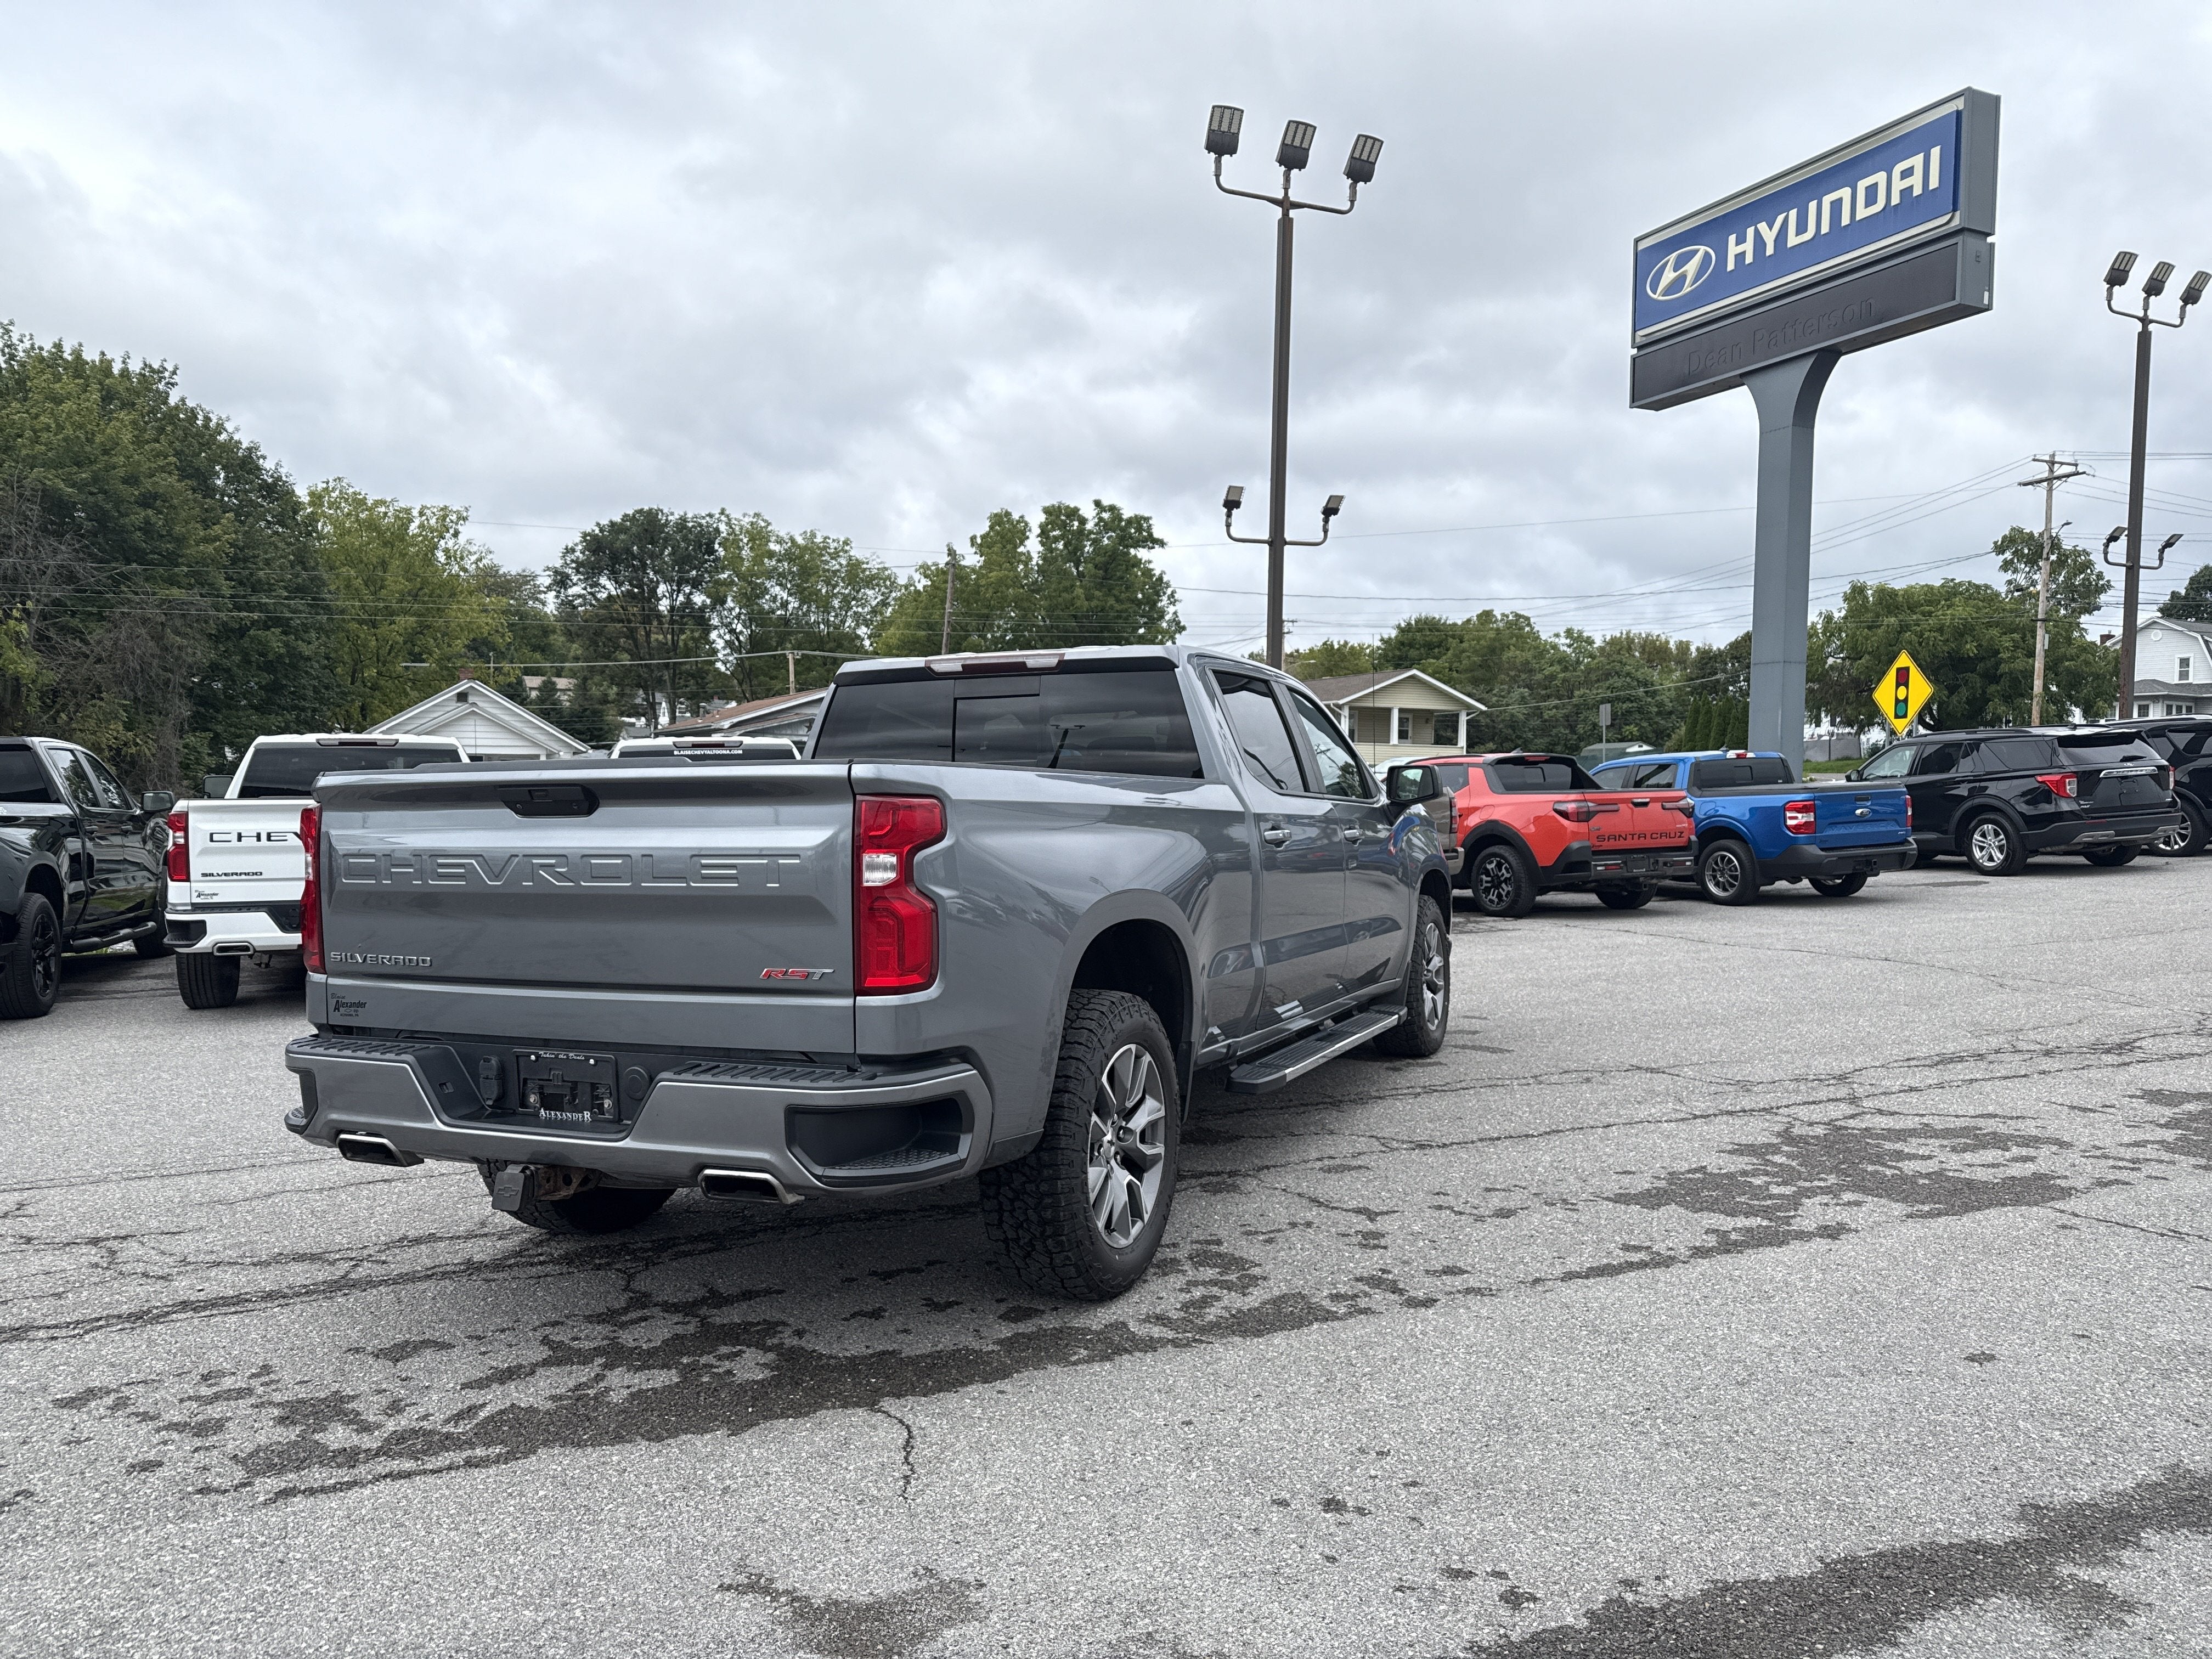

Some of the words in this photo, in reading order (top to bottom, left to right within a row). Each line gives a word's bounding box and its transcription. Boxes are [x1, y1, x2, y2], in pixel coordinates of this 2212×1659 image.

[1726, 145, 1941, 272] HYUNDAI
[1688, 342, 1742, 376] Dean
[1753, 297, 1874, 356] Patterson
[1596, 833, 1646, 842] SANTA
[1650, 831, 1685, 840] CRUZ
[342, 853, 801, 887] CHEVROLET
[330, 952, 432, 967] SILVERADO
[759, 968, 834, 980] RST
[333, 1000, 368, 1012] Alexander
